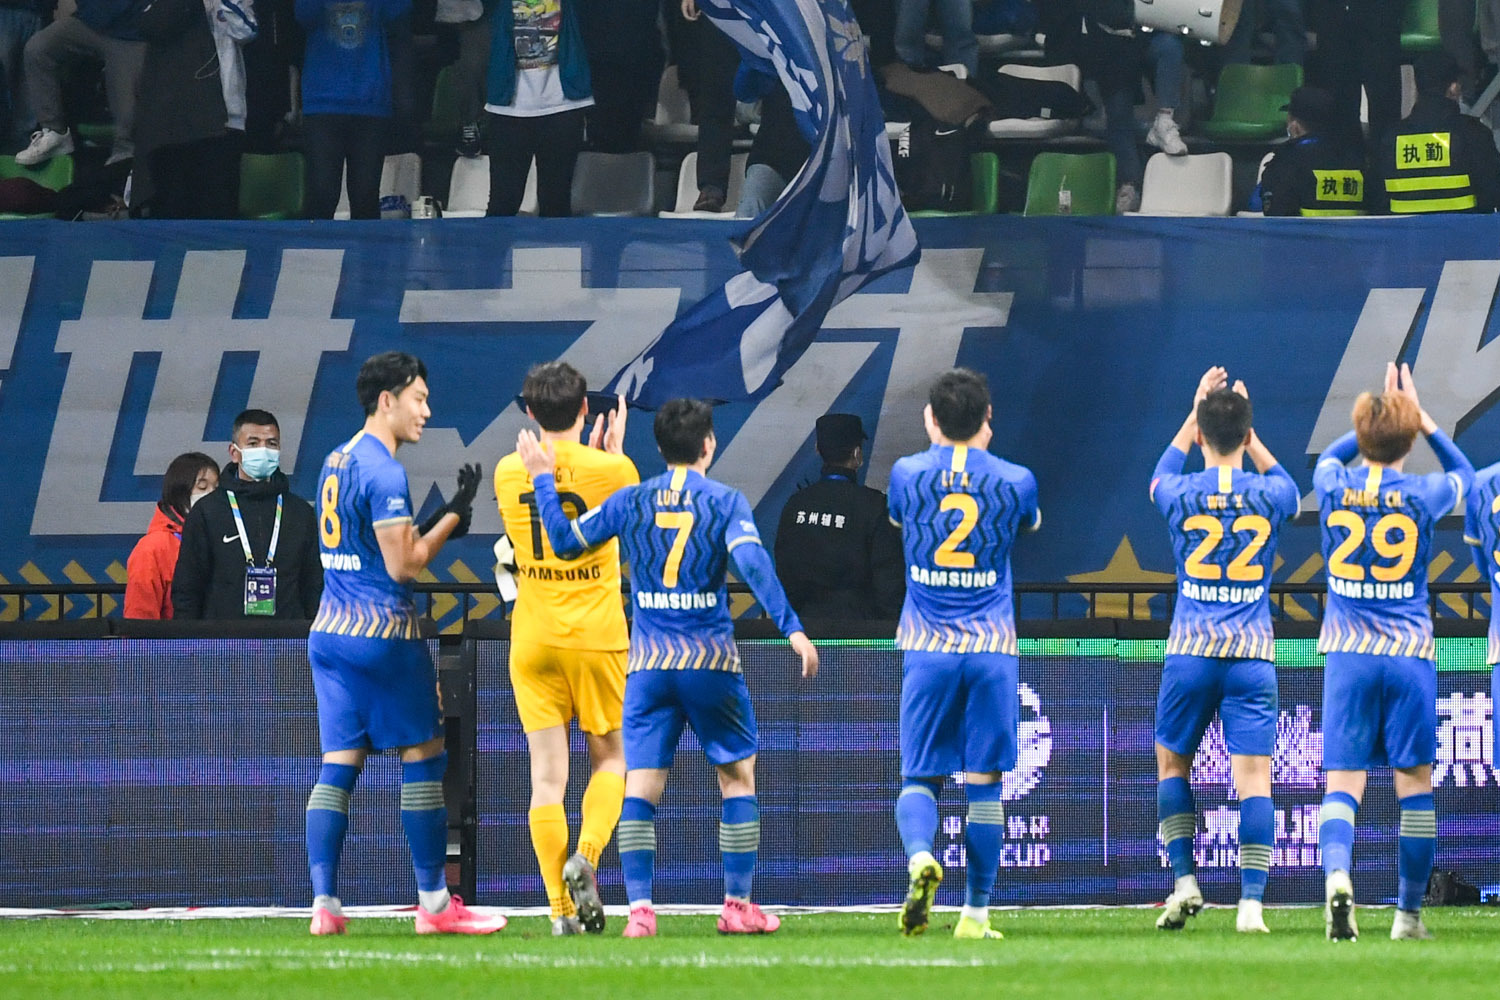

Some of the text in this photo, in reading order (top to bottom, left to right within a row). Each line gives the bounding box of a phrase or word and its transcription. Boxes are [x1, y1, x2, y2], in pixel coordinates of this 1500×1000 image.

[1402, 142, 1443, 164] 执勤
[1321, 176, 1359, 197] 执勤
[0, 246, 1015, 537] 世之才
[941, 469, 955, 488] LI
[656, 490, 679, 507] LUO
[1206, 494, 1227, 510] WU
[1341, 487, 1380, 508] ZHANG
[320, 473, 341, 549] 8
[933, 492, 980, 568] 2
[654, 511, 694, 588] 7
[1183, 514, 1272, 581] 22
[1326, 509, 1420, 582] 29
[519, 564, 601, 581] SAMSUNG
[909, 564, 998, 588] SAMSUNG
[637, 590, 718, 610] SAMSUNG
[1181, 580, 1265, 604] SAMSUNG
[1327, 576, 1415, 600] SAMSUNG
[943, 815, 1050, 839] 中协杯
